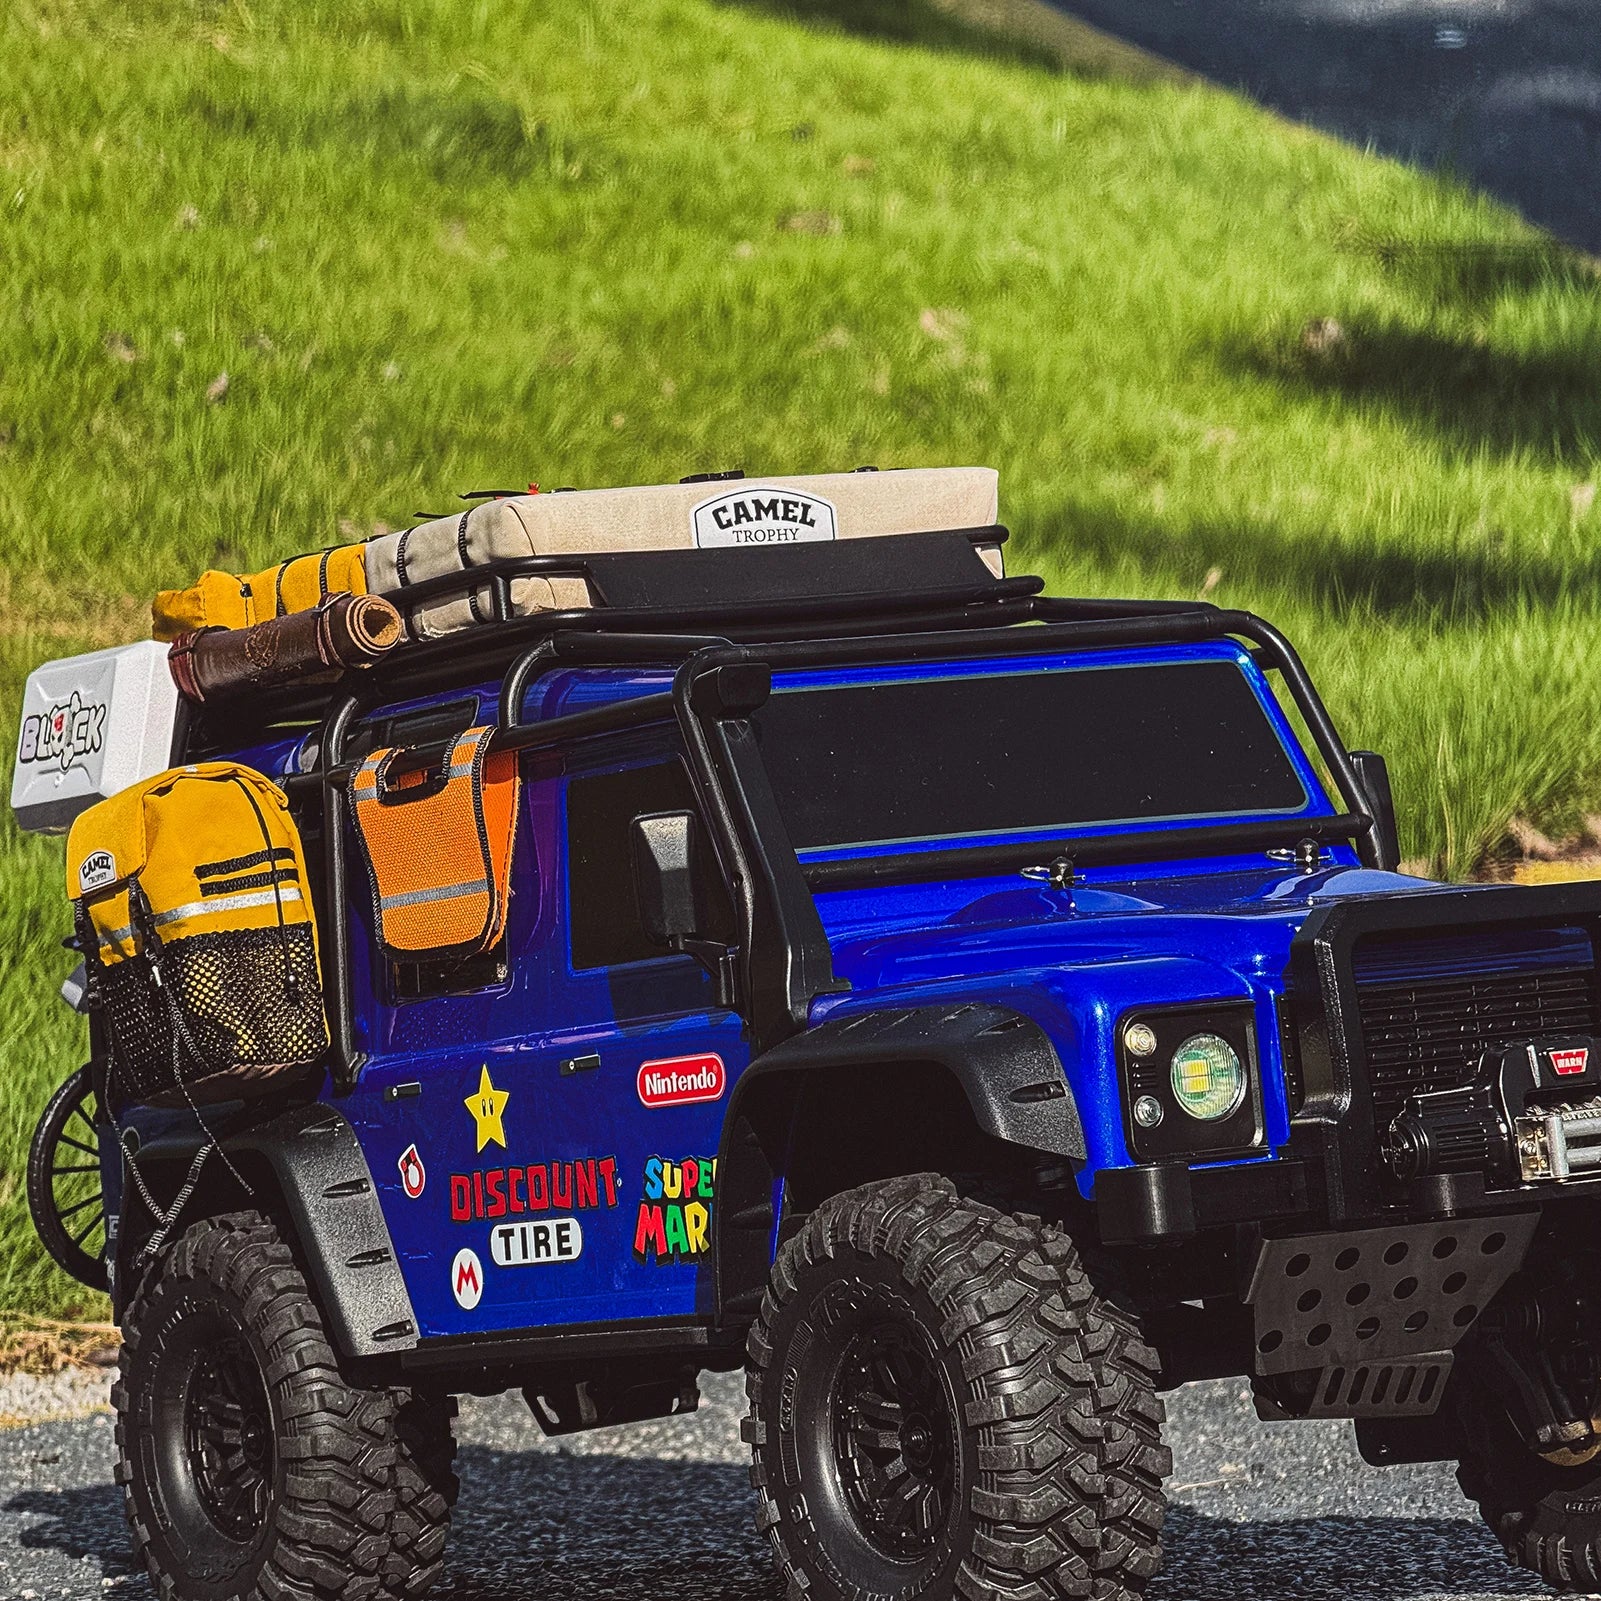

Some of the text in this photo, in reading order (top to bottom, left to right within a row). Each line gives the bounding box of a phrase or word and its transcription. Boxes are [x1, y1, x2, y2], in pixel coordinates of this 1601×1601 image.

[712, 498, 816, 530] CAMEL
[732, 528, 800, 543] TROPHY
[82, 856, 111, 879] CAMEL
[1556, 1056, 1583, 1069] WARN
[645, 1065, 717, 1096] Nintendo
[450, 1156, 617, 1221] DISCOUNT
[644, 1157, 718, 1199] SUPE
[498, 1222, 573, 1261] TIRE
[634, 1201, 713, 1256] MAR
[456, 1260, 479, 1296] M
